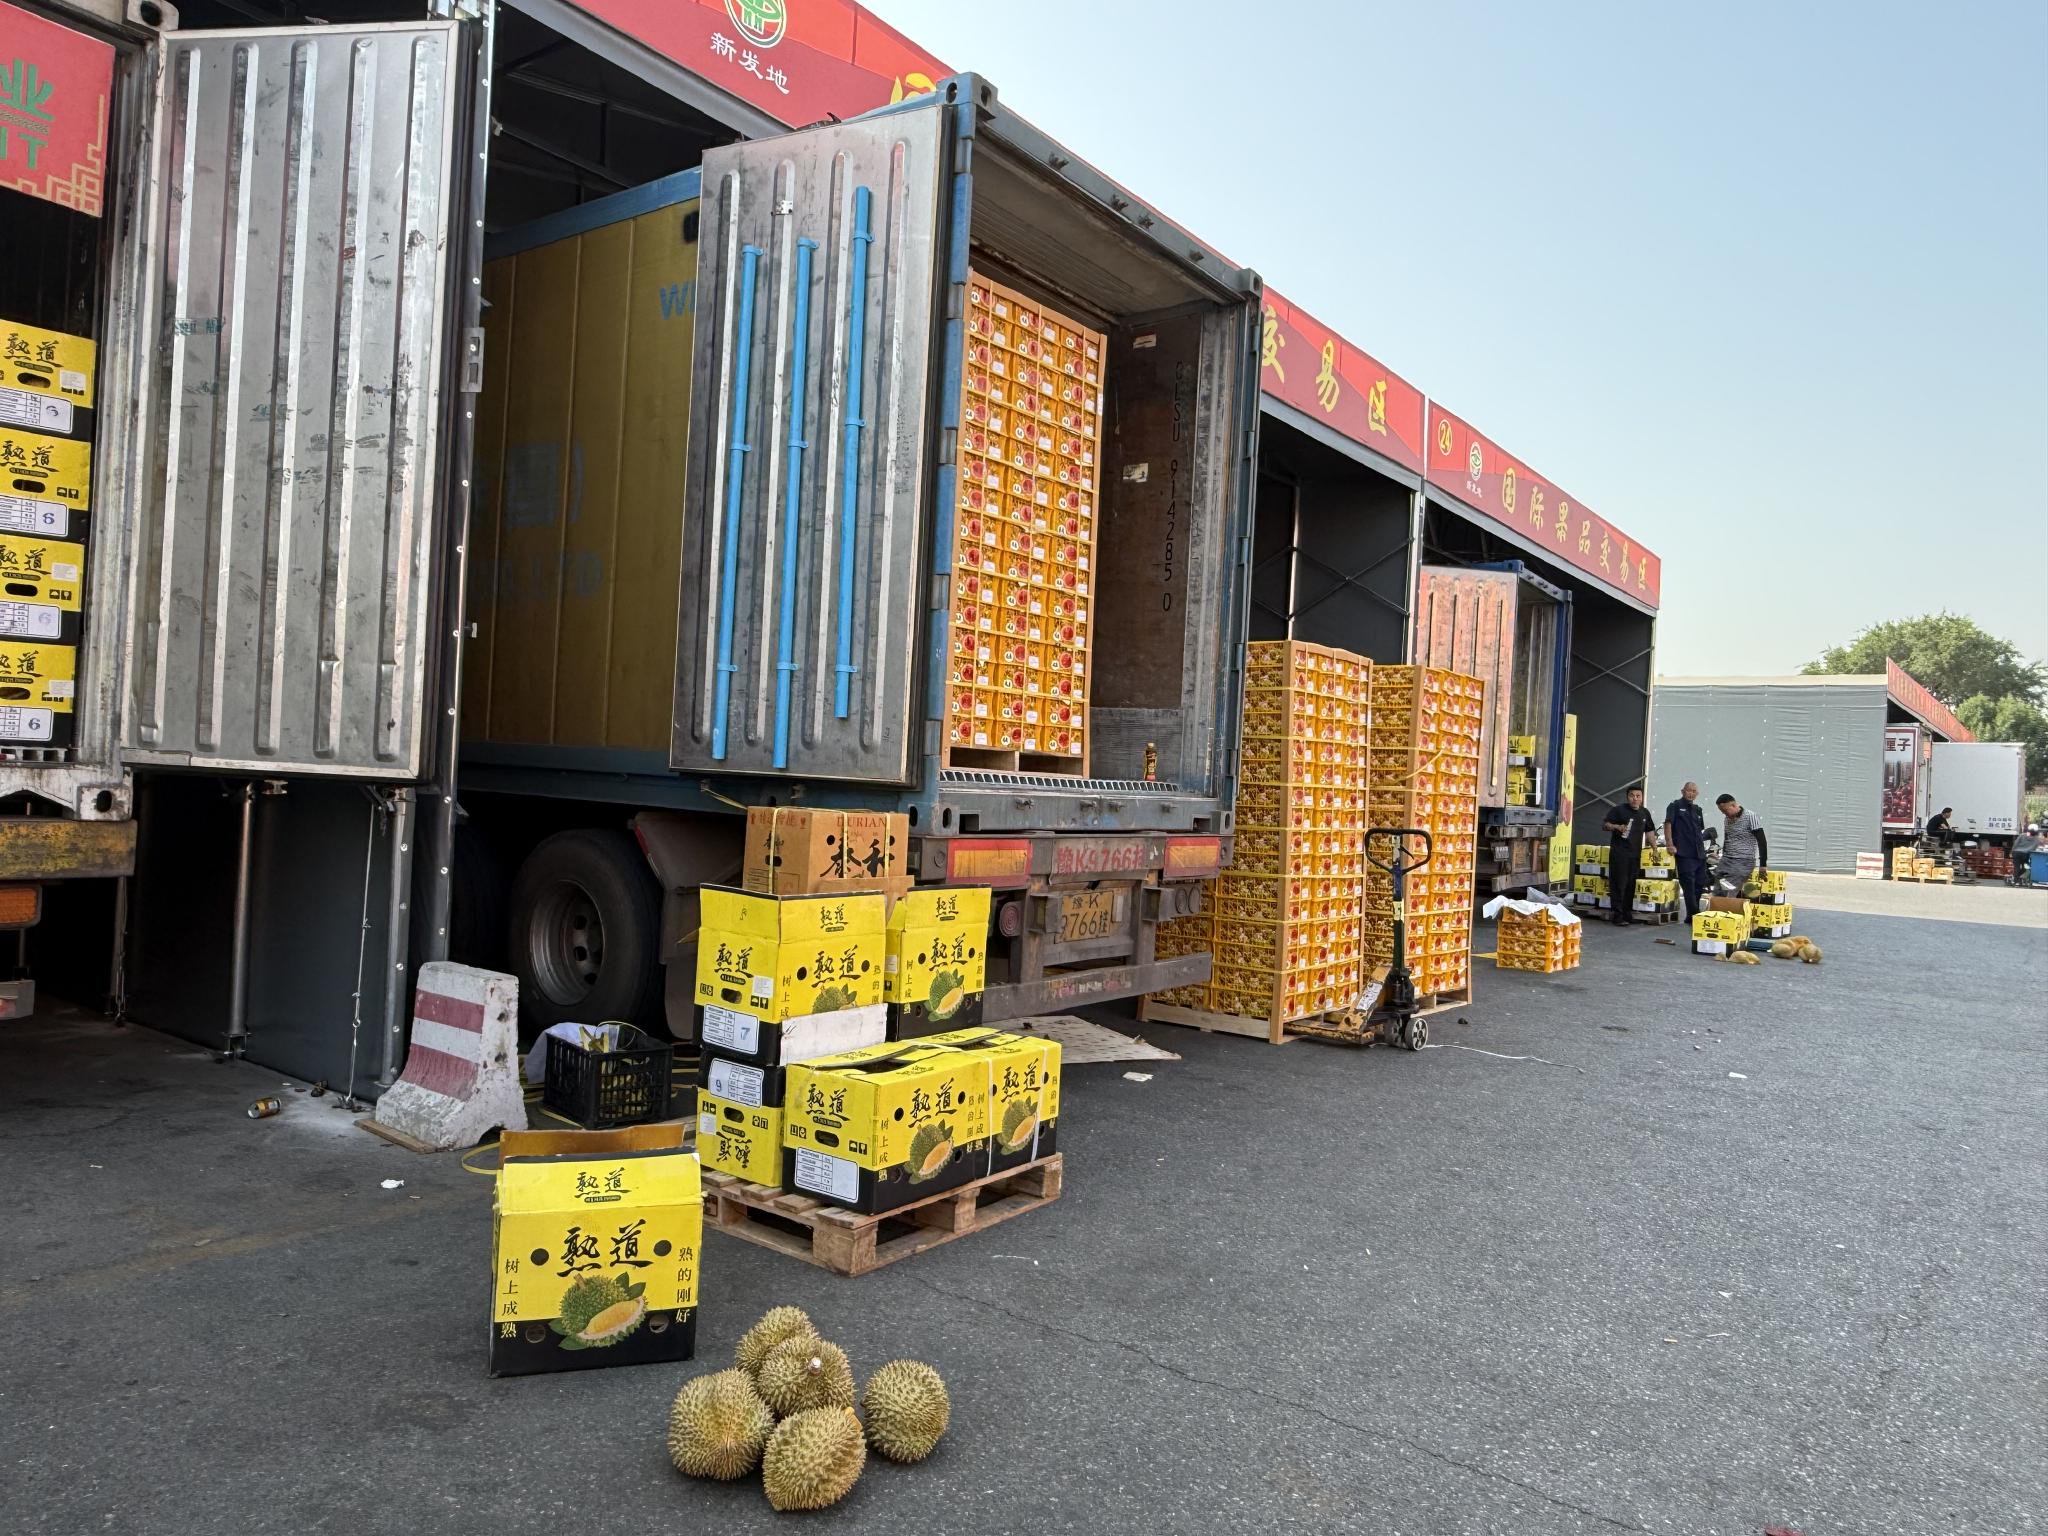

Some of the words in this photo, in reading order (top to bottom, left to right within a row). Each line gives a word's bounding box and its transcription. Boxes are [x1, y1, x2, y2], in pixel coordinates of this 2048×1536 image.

[711, 32, 790, 94] 新发地
[1440, 421, 1452, 454] 24
[42, 512, 55, 524] 6
[28, 717, 41, 731] 6
[740, 1027, 750, 1041] 7
[574, 1167, 632, 1198] 熟道
[556, 1218, 654, 1277] 熟道
[500, 1258, 520, 1338] 树上成熟
[675, 1247, 693, 1325] 熟的刚好
